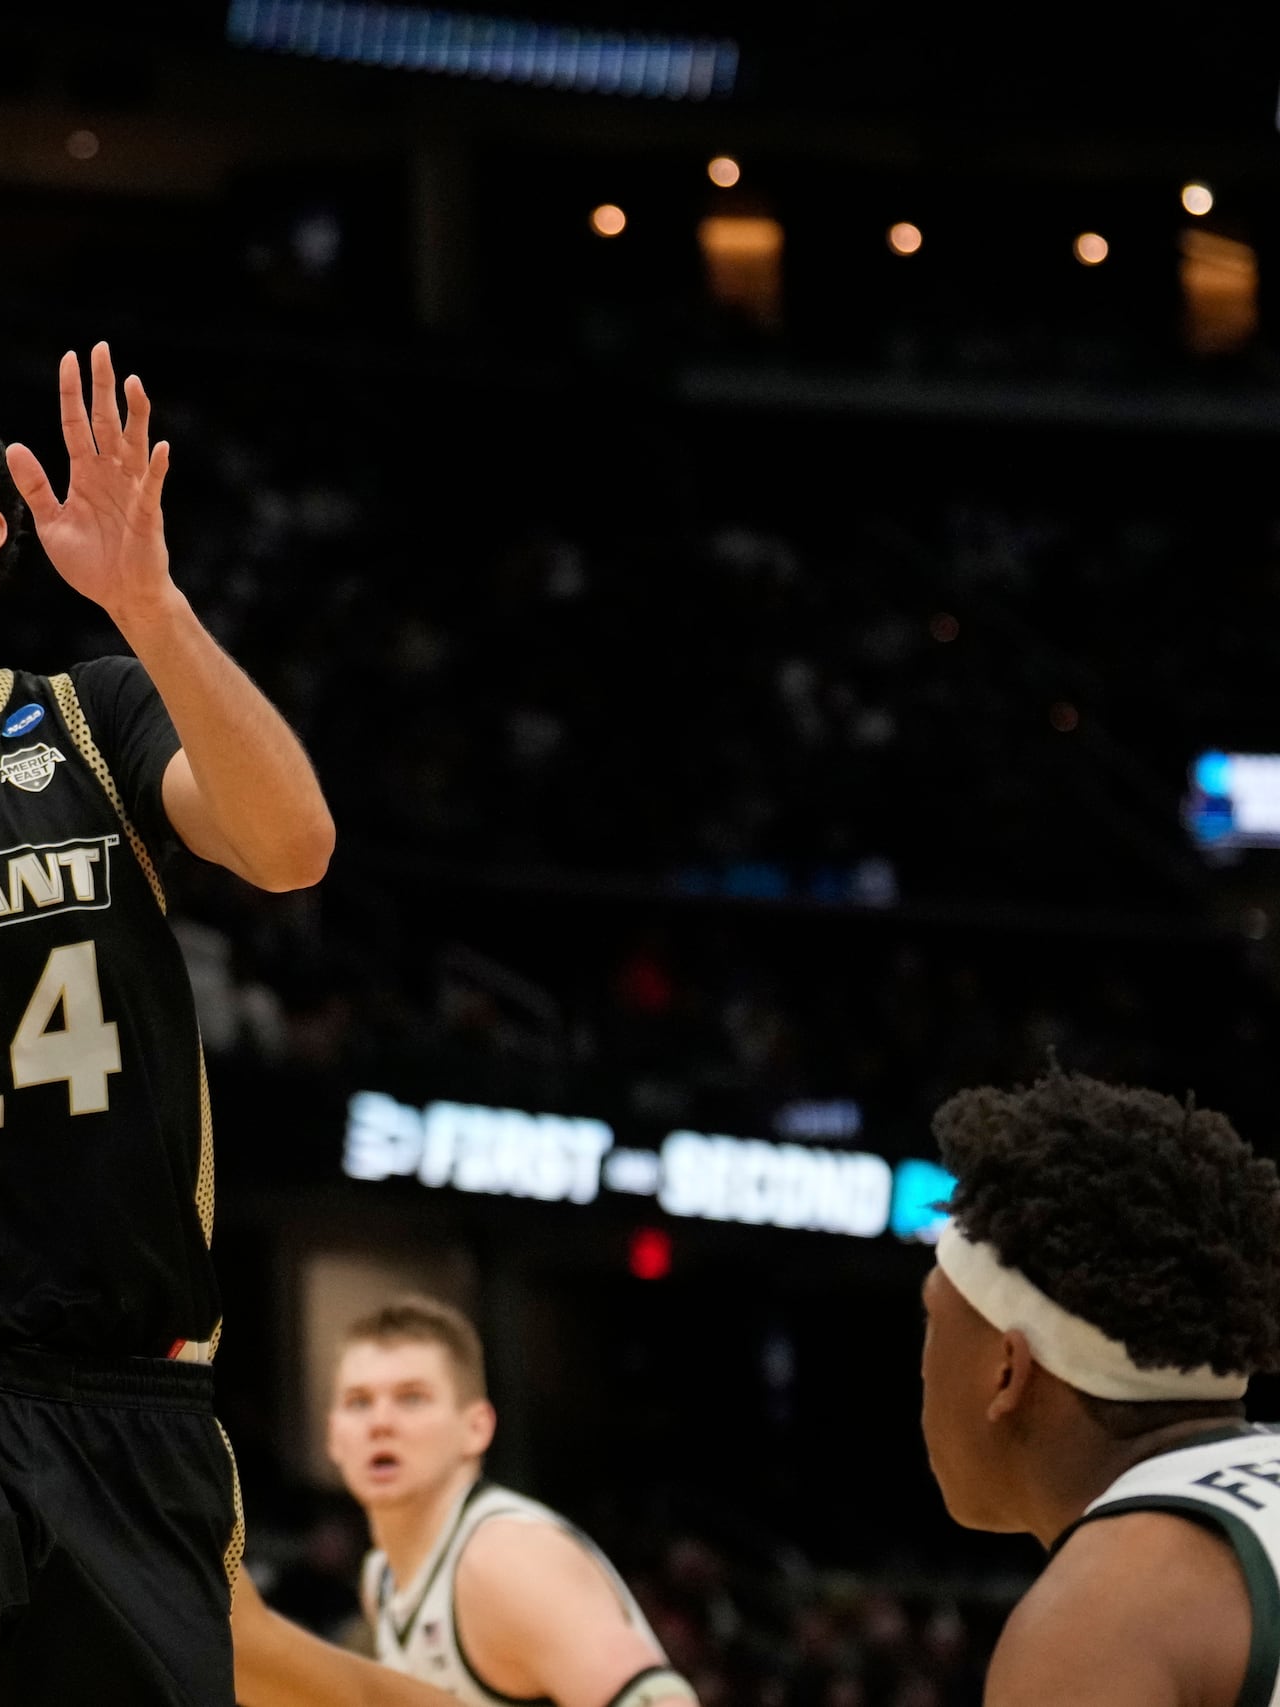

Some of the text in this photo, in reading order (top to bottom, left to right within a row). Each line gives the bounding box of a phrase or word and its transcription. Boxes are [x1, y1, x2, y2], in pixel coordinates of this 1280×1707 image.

[7, 710, 42, 735] NCAA
[0, 749, 59, 777] AMERICA
[14, 763, 49, 783] EAST
